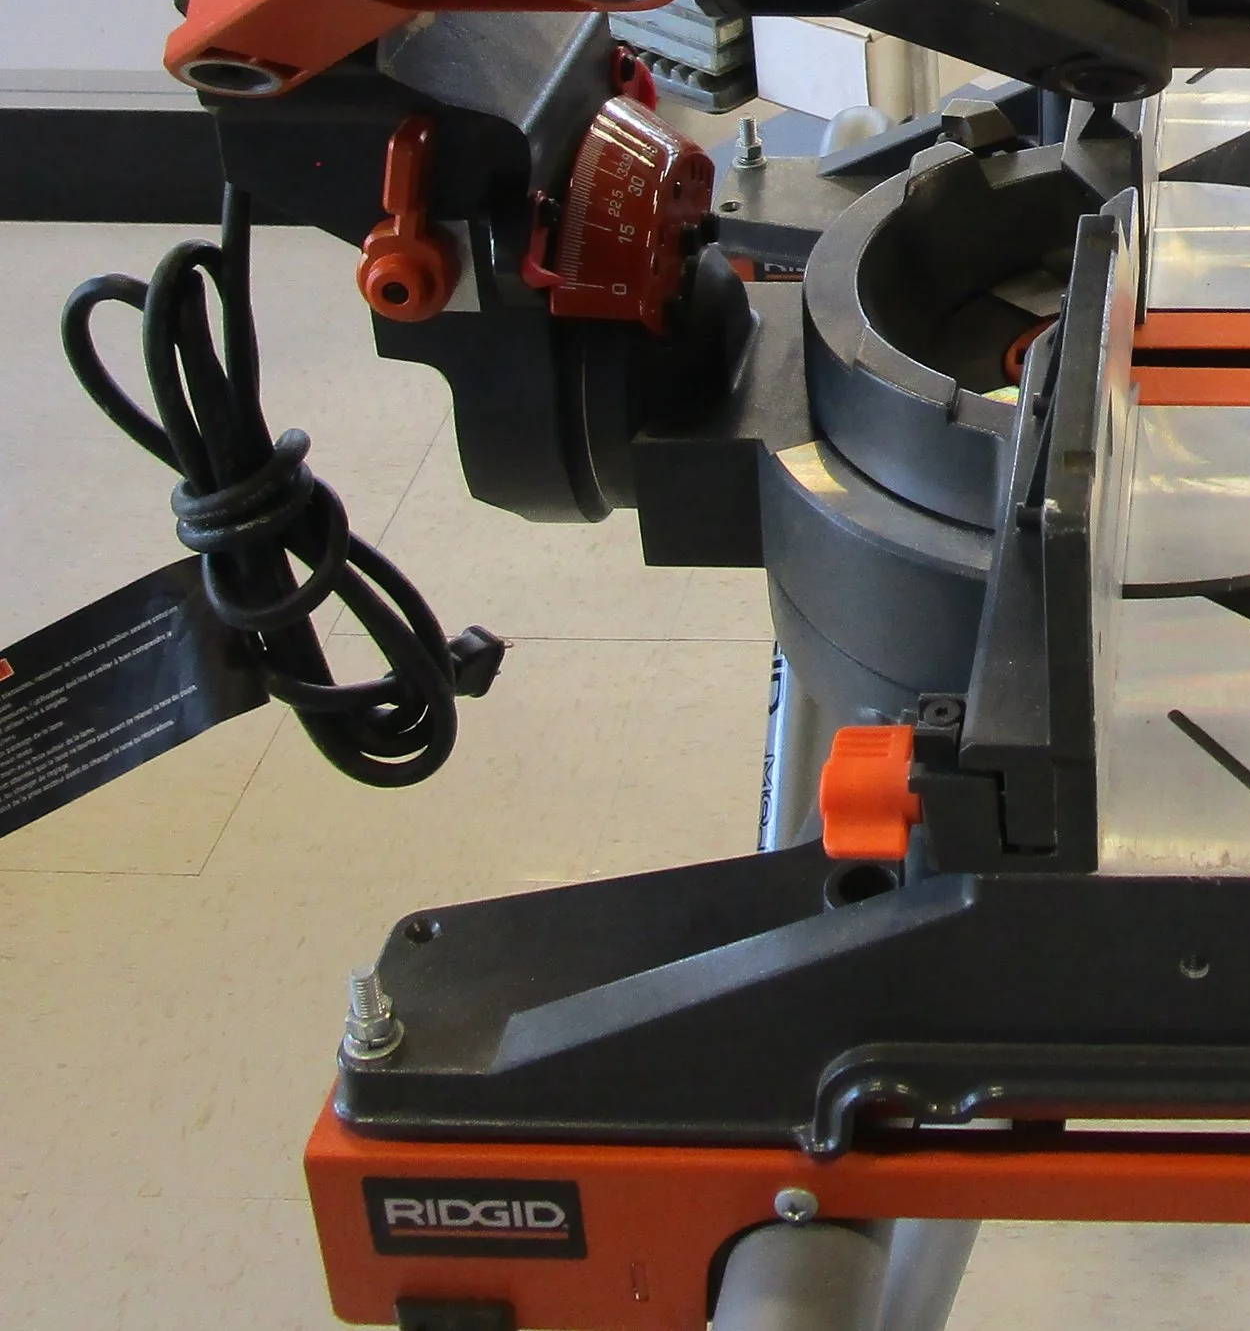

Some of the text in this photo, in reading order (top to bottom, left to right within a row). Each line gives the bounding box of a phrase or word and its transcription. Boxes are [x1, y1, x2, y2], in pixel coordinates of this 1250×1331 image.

[628, 175, 646, 197] 30
[617, 223, 636, 244] 15
[612, 282, 627, 296] 0
[383, 1197, 566, 1229] RIDGID
